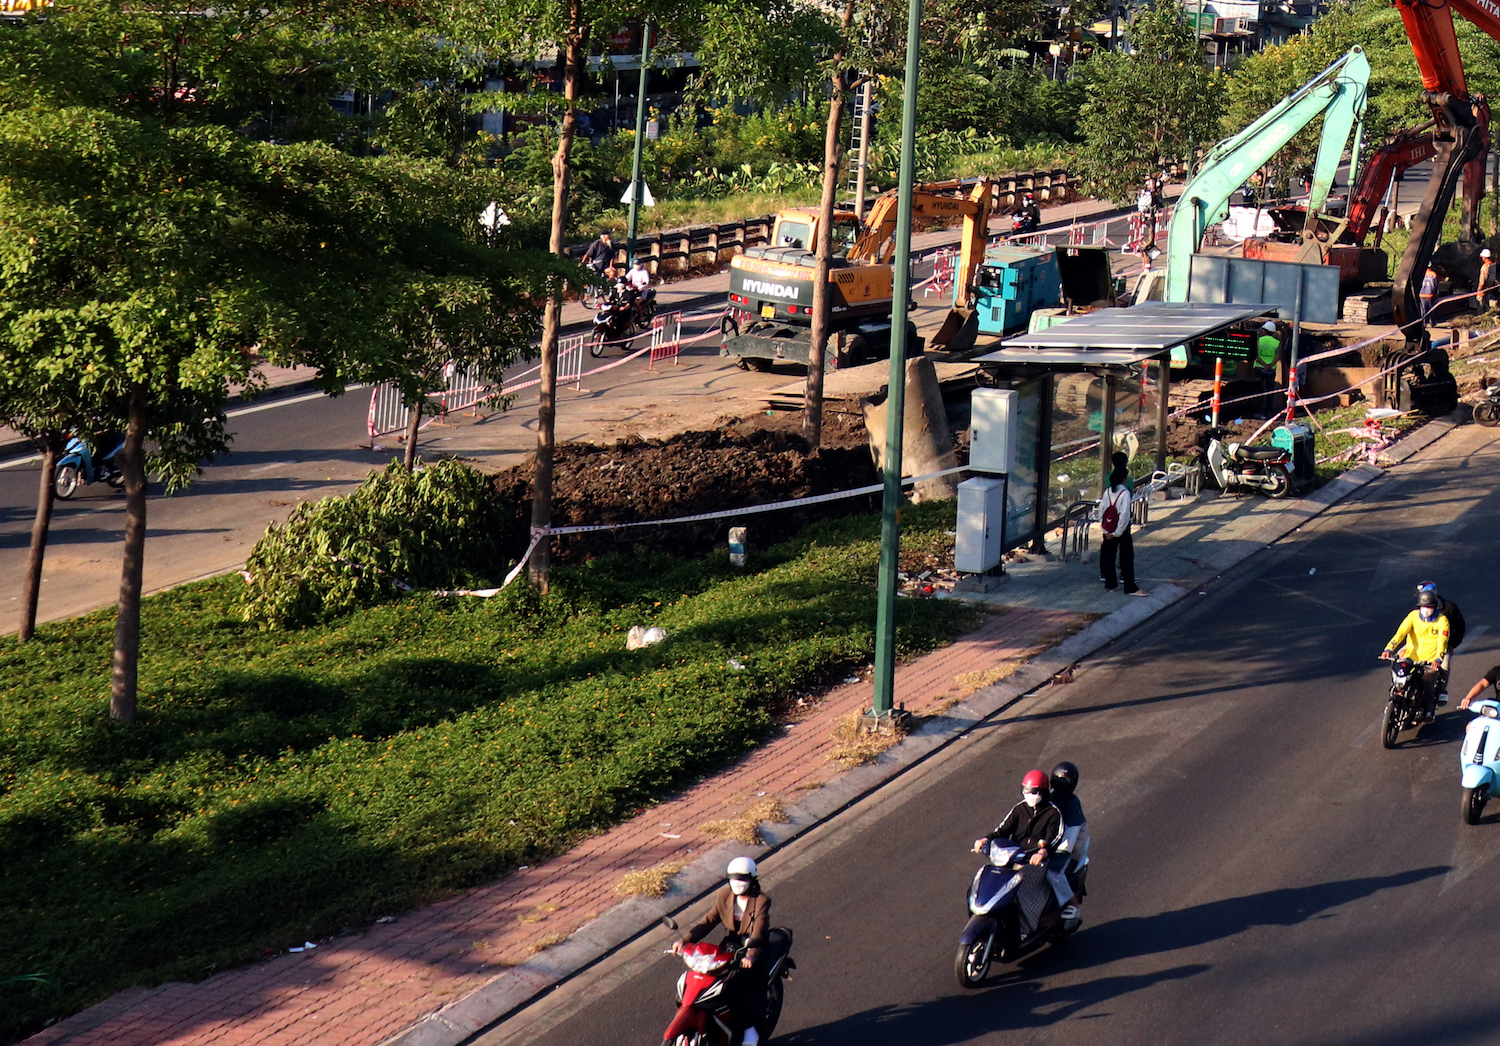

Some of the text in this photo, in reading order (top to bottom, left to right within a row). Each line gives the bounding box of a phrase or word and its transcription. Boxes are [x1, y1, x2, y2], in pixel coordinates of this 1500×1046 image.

[1410, 145, 1426, 160] IHI
[932, 201, 960, 211] HYUNDAI
[742, 279, 799, 300] HYUNDAI
